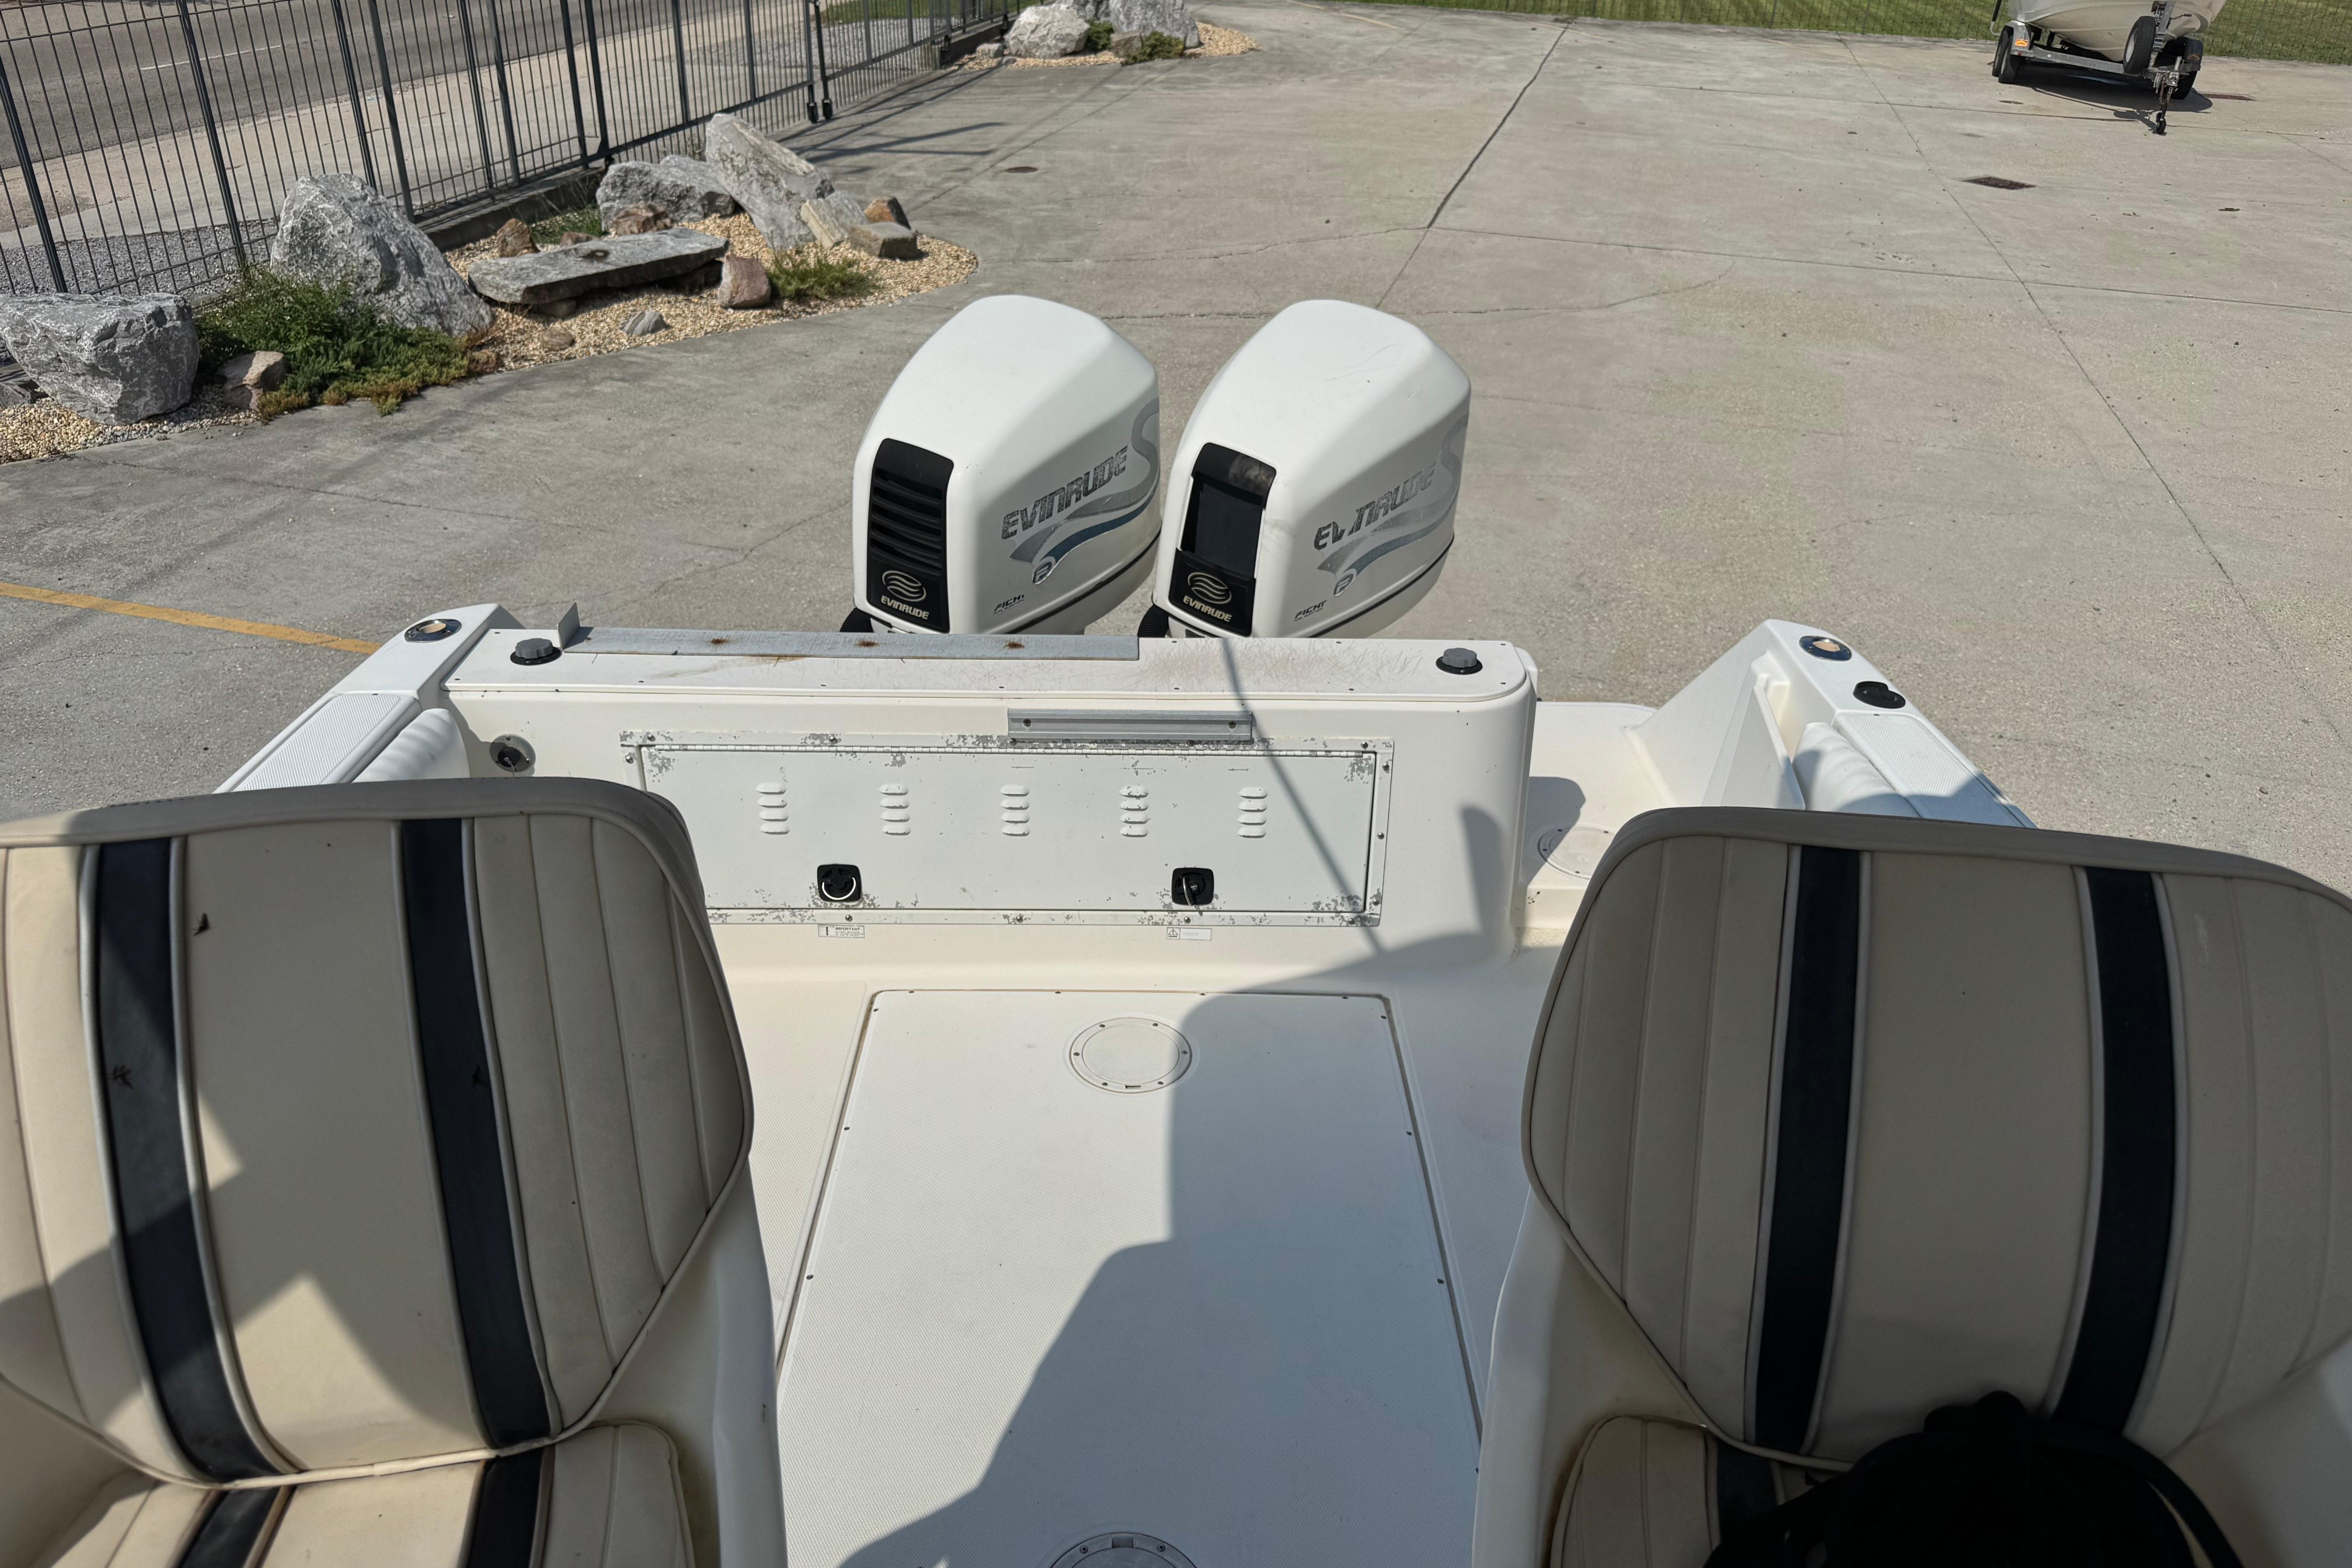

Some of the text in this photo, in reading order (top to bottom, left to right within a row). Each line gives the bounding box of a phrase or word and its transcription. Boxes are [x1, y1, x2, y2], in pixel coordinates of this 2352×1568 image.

[1001, 446, 1128, 540] EVINRUDE
[881, 595, 929, 620] EVINRUDE
[1183, 595, 1232, 622] EVINRUDE
